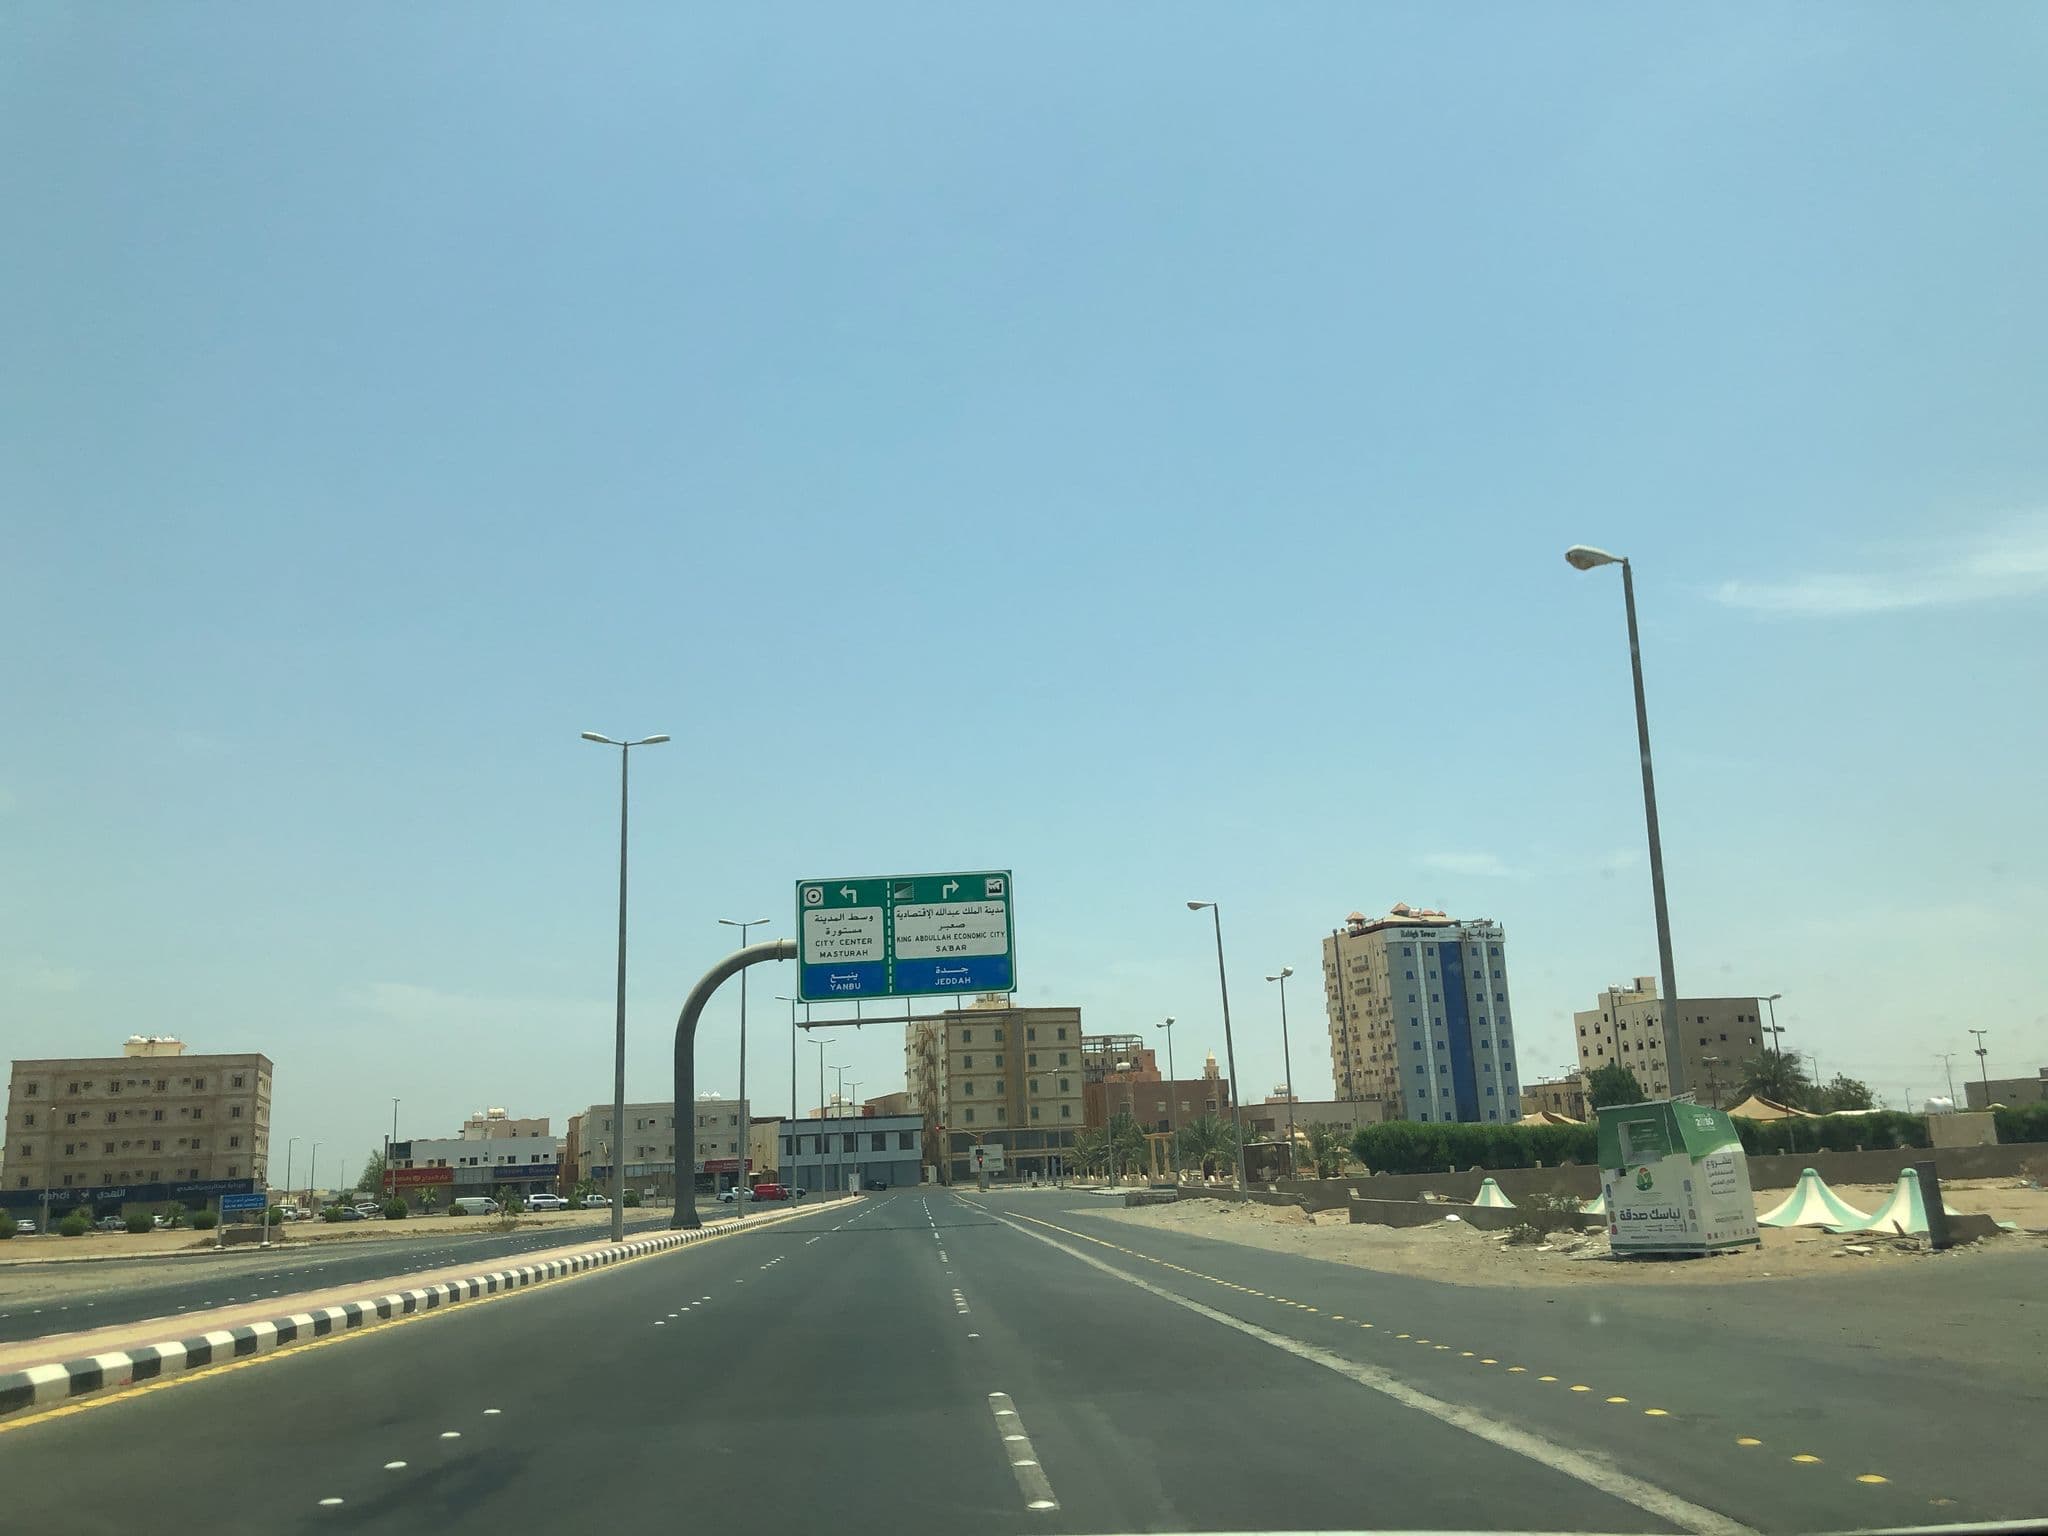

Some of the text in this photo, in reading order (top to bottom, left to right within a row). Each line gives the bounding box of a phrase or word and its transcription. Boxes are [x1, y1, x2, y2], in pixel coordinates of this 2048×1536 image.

[935, 907, 960, 917] عبدالله
[963, 906, 982, 915] الملك
[984, 906, 1004, 917] مدينة
[814, 913, 874, 924] وسط المدينة
[825, 927, 862, 937] مستورة
[897, 935, 912, 943] KING
[915, 933, 951, 942] ABDULLAH
[954, 931, 987, 940] ECONOMIC
[1420, 930, 1436, 938] Tower
[815, 937, 873, 947] CITY CENTER
[819, 949, 869, 958] MASTURAH
[935, 965, 969, 974] جدة
[830, 971, 858, 983] ينبع
[934, 976, 971, 986] JEDDAH
[830, 982, 861, 991] YANBU
[1619, 1207, 1681, 1221] لباسك صدقة
